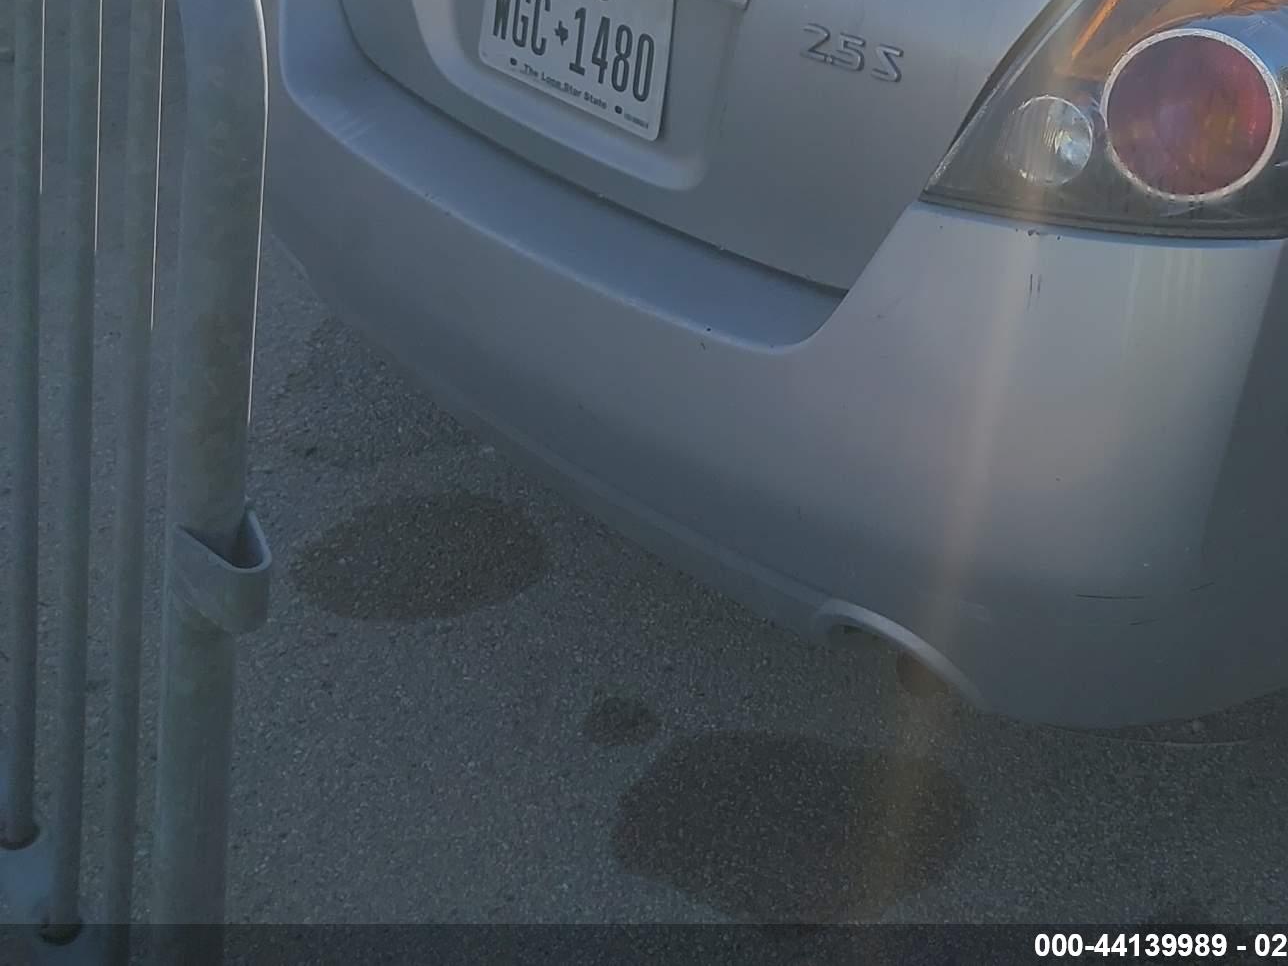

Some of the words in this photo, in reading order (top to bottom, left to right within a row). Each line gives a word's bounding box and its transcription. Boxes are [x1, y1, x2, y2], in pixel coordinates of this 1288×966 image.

[524, 63, 539, 77] The
[541, 72, 562, 90] Lone
[564, 82, 582, 97] Star
[584, 91, 607, 109] State
[569, 7, 655, 102] 1480
